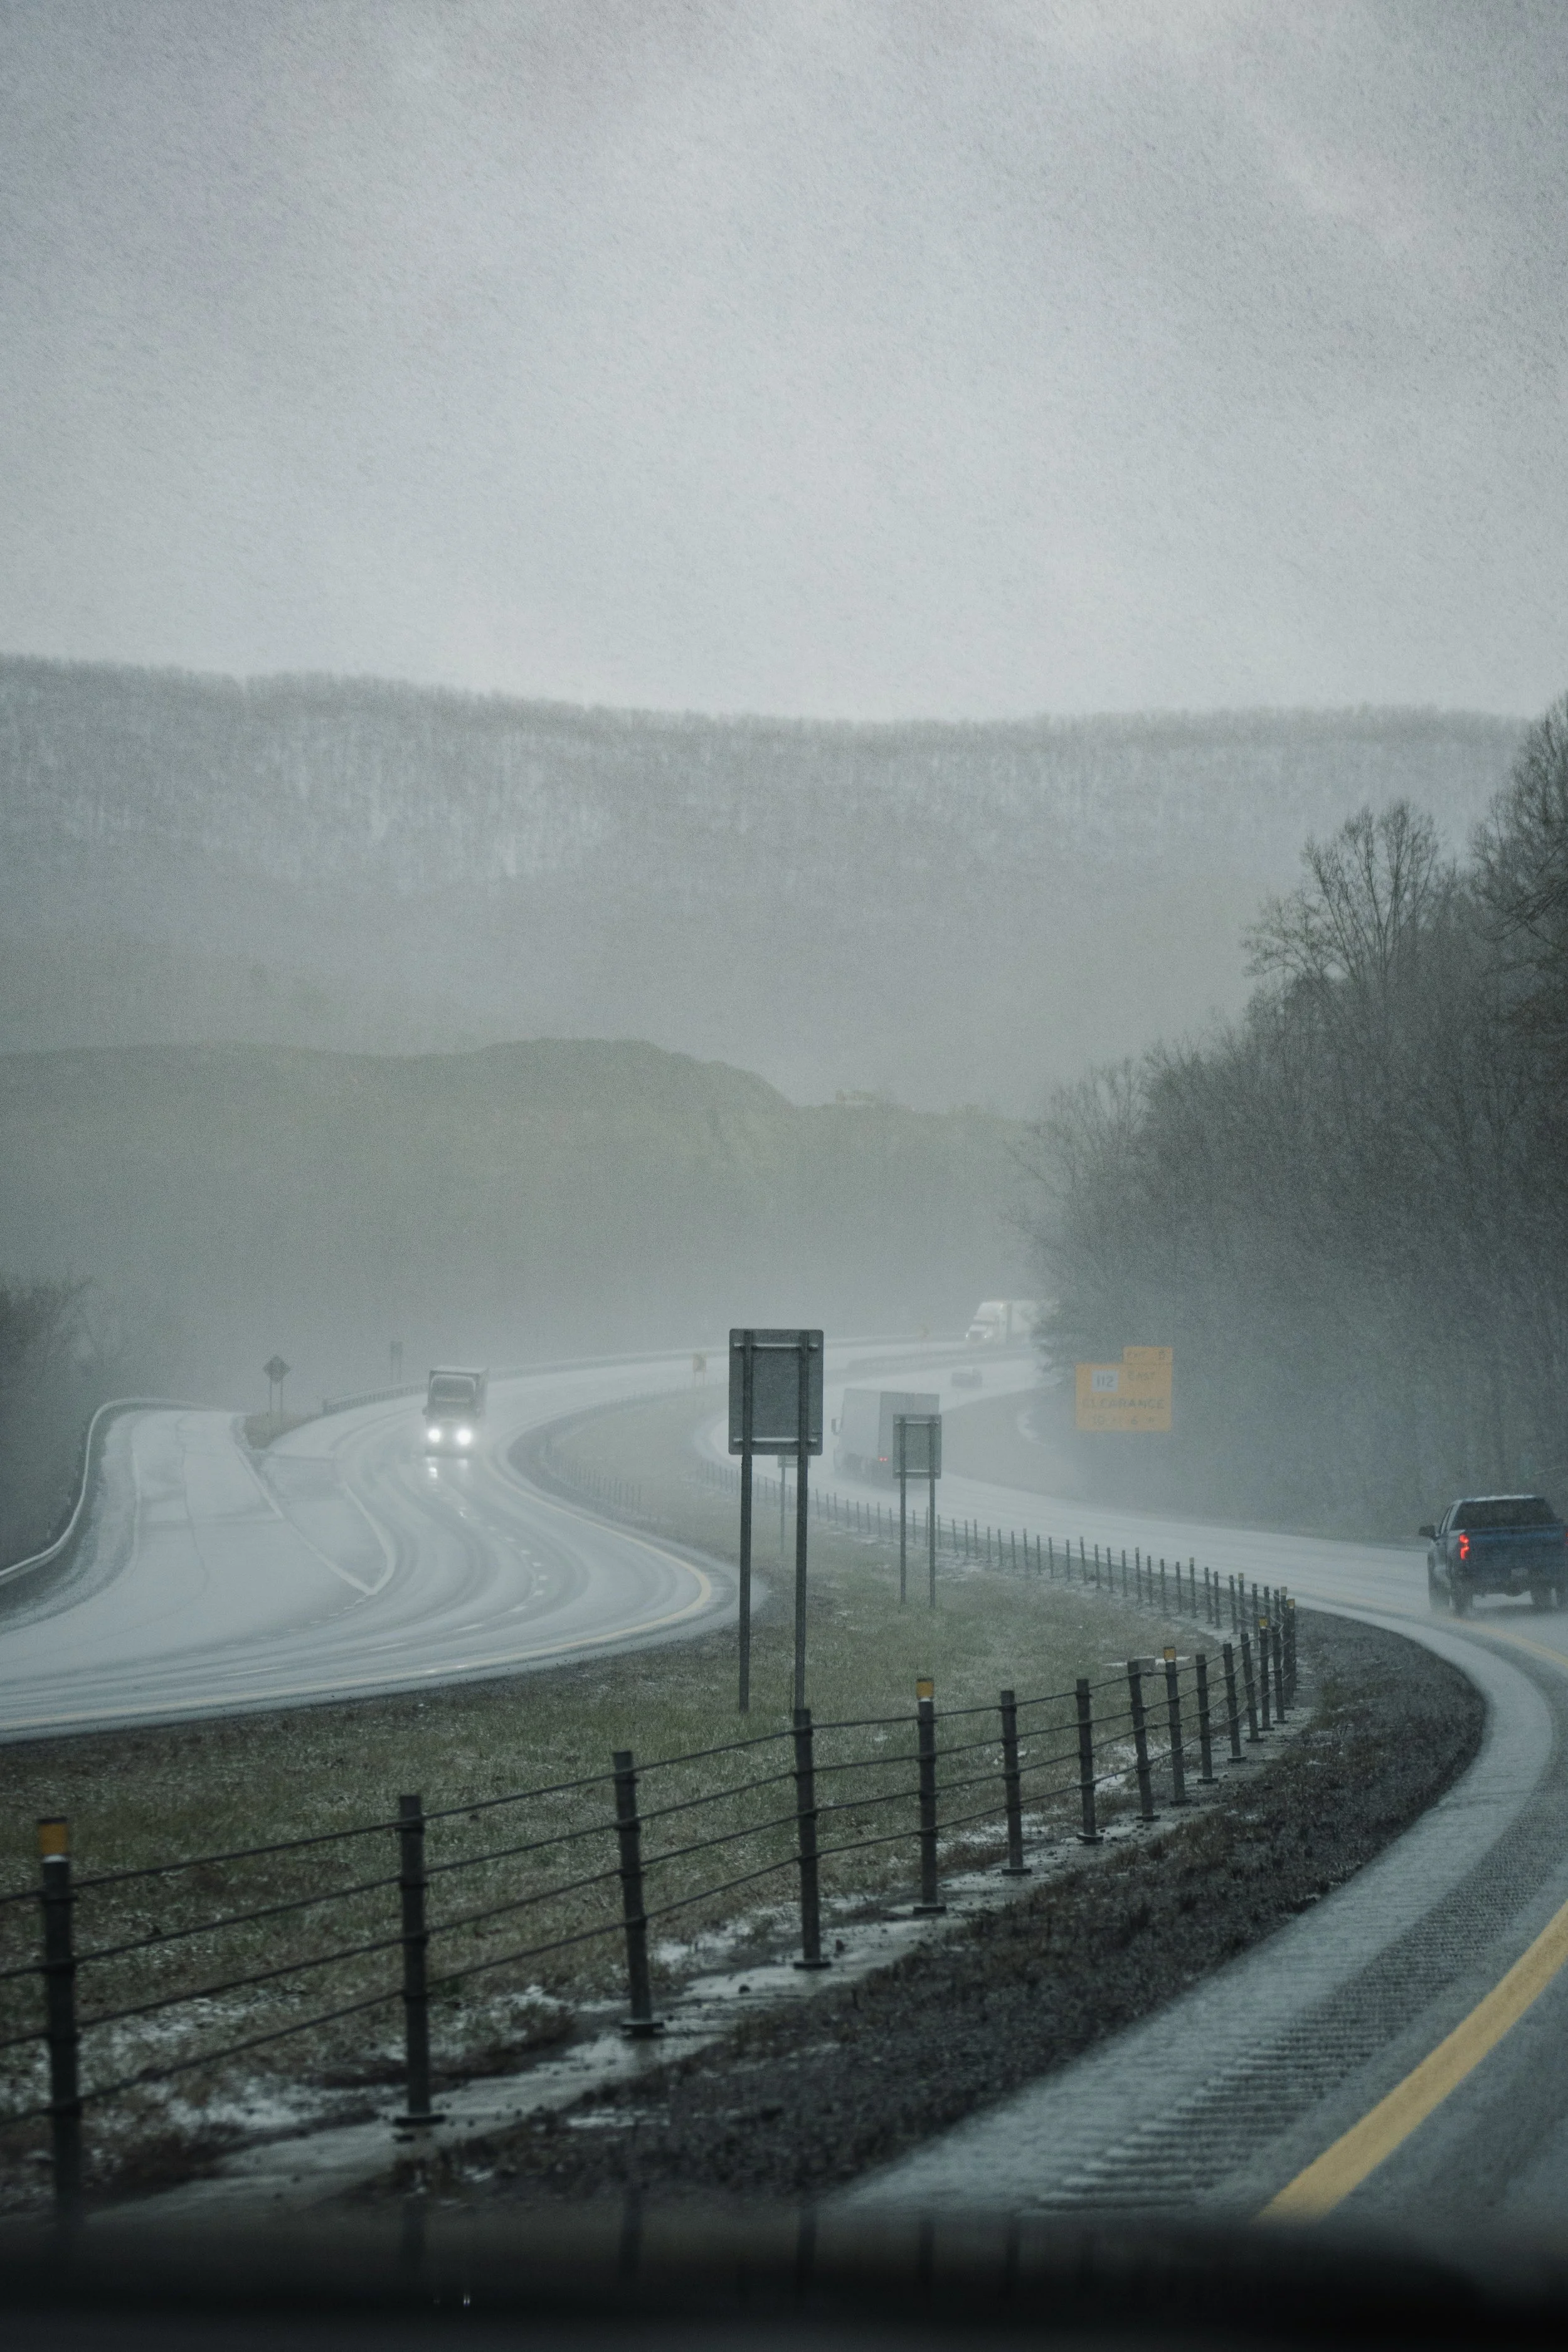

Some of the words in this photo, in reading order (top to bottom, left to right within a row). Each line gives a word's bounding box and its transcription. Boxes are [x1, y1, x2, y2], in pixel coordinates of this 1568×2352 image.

[1096, 1375, 1114, 1387] 112
[1127, 1370, 1155, 1381] EAST
[1082, 1398, 1165, 1409] CLEARANCE
